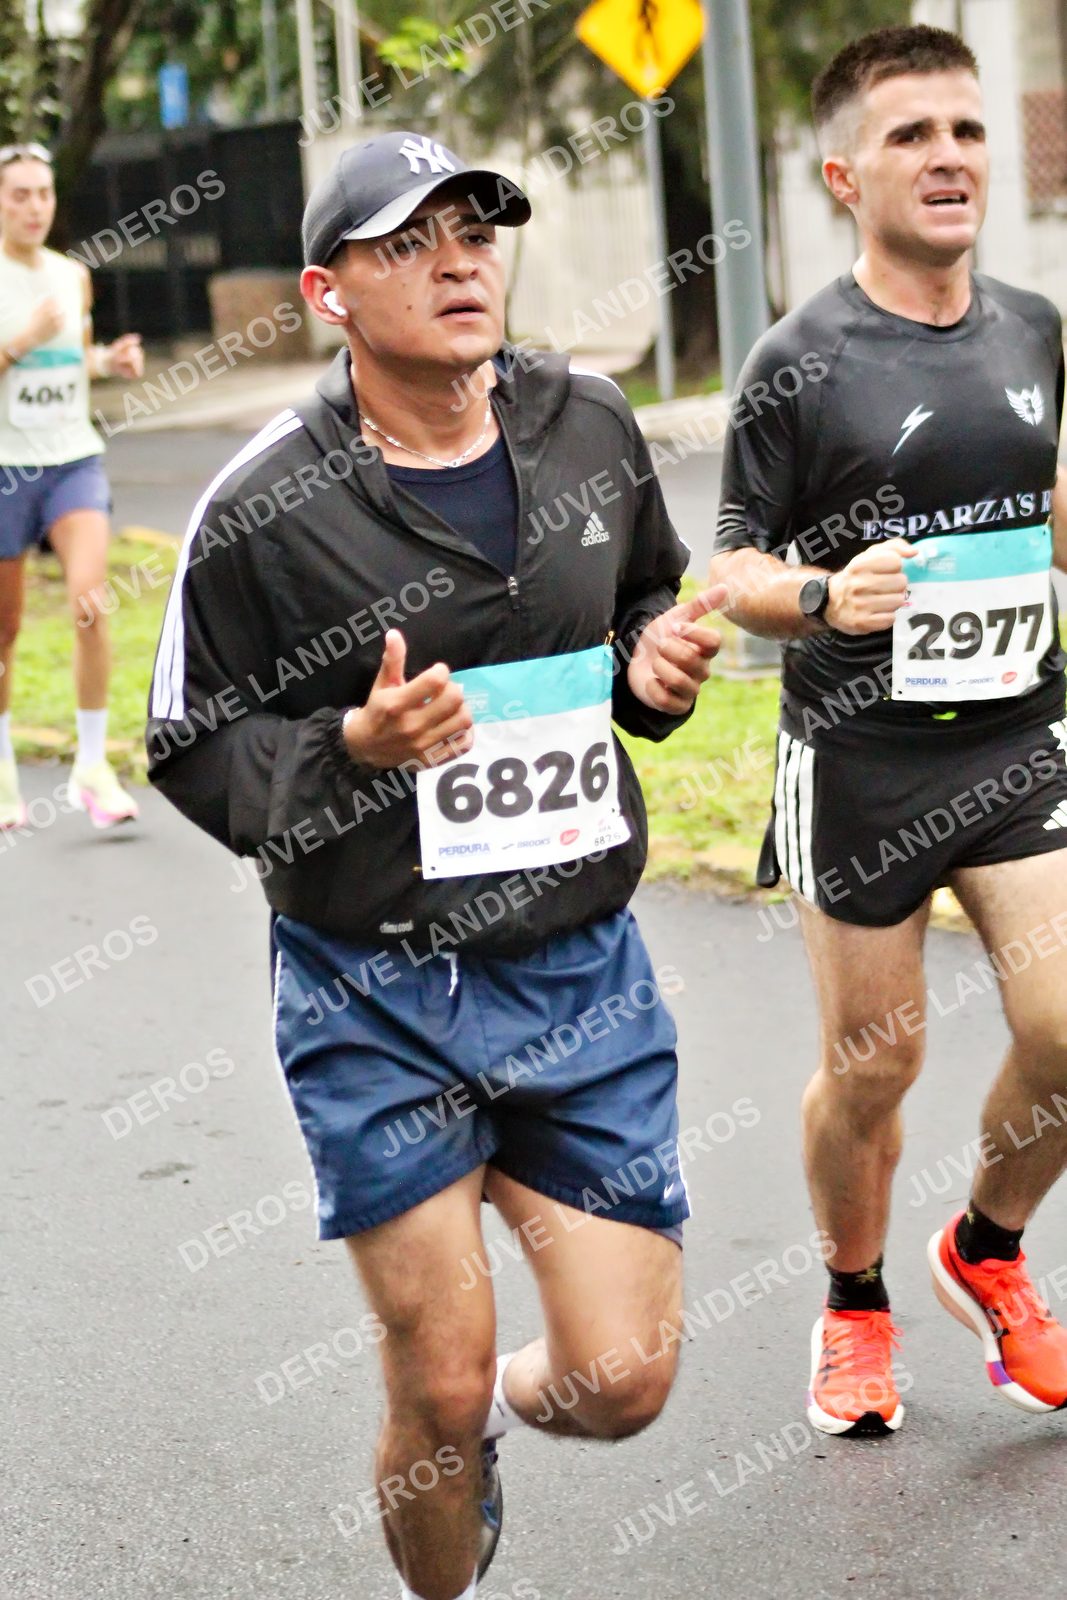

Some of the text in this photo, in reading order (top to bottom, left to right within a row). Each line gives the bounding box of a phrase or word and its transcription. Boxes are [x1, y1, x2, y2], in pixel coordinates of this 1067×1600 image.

[861, 492, 1036, 541] ESPARZA'S
[581, 531, 610, 546] adidas
[907, 602, 1045, 660] 2977
[904, 677, 948, 686] PERDURA
[436, 741, 610, 824] 6826
[438, 843, 491, 857] PERDURA
